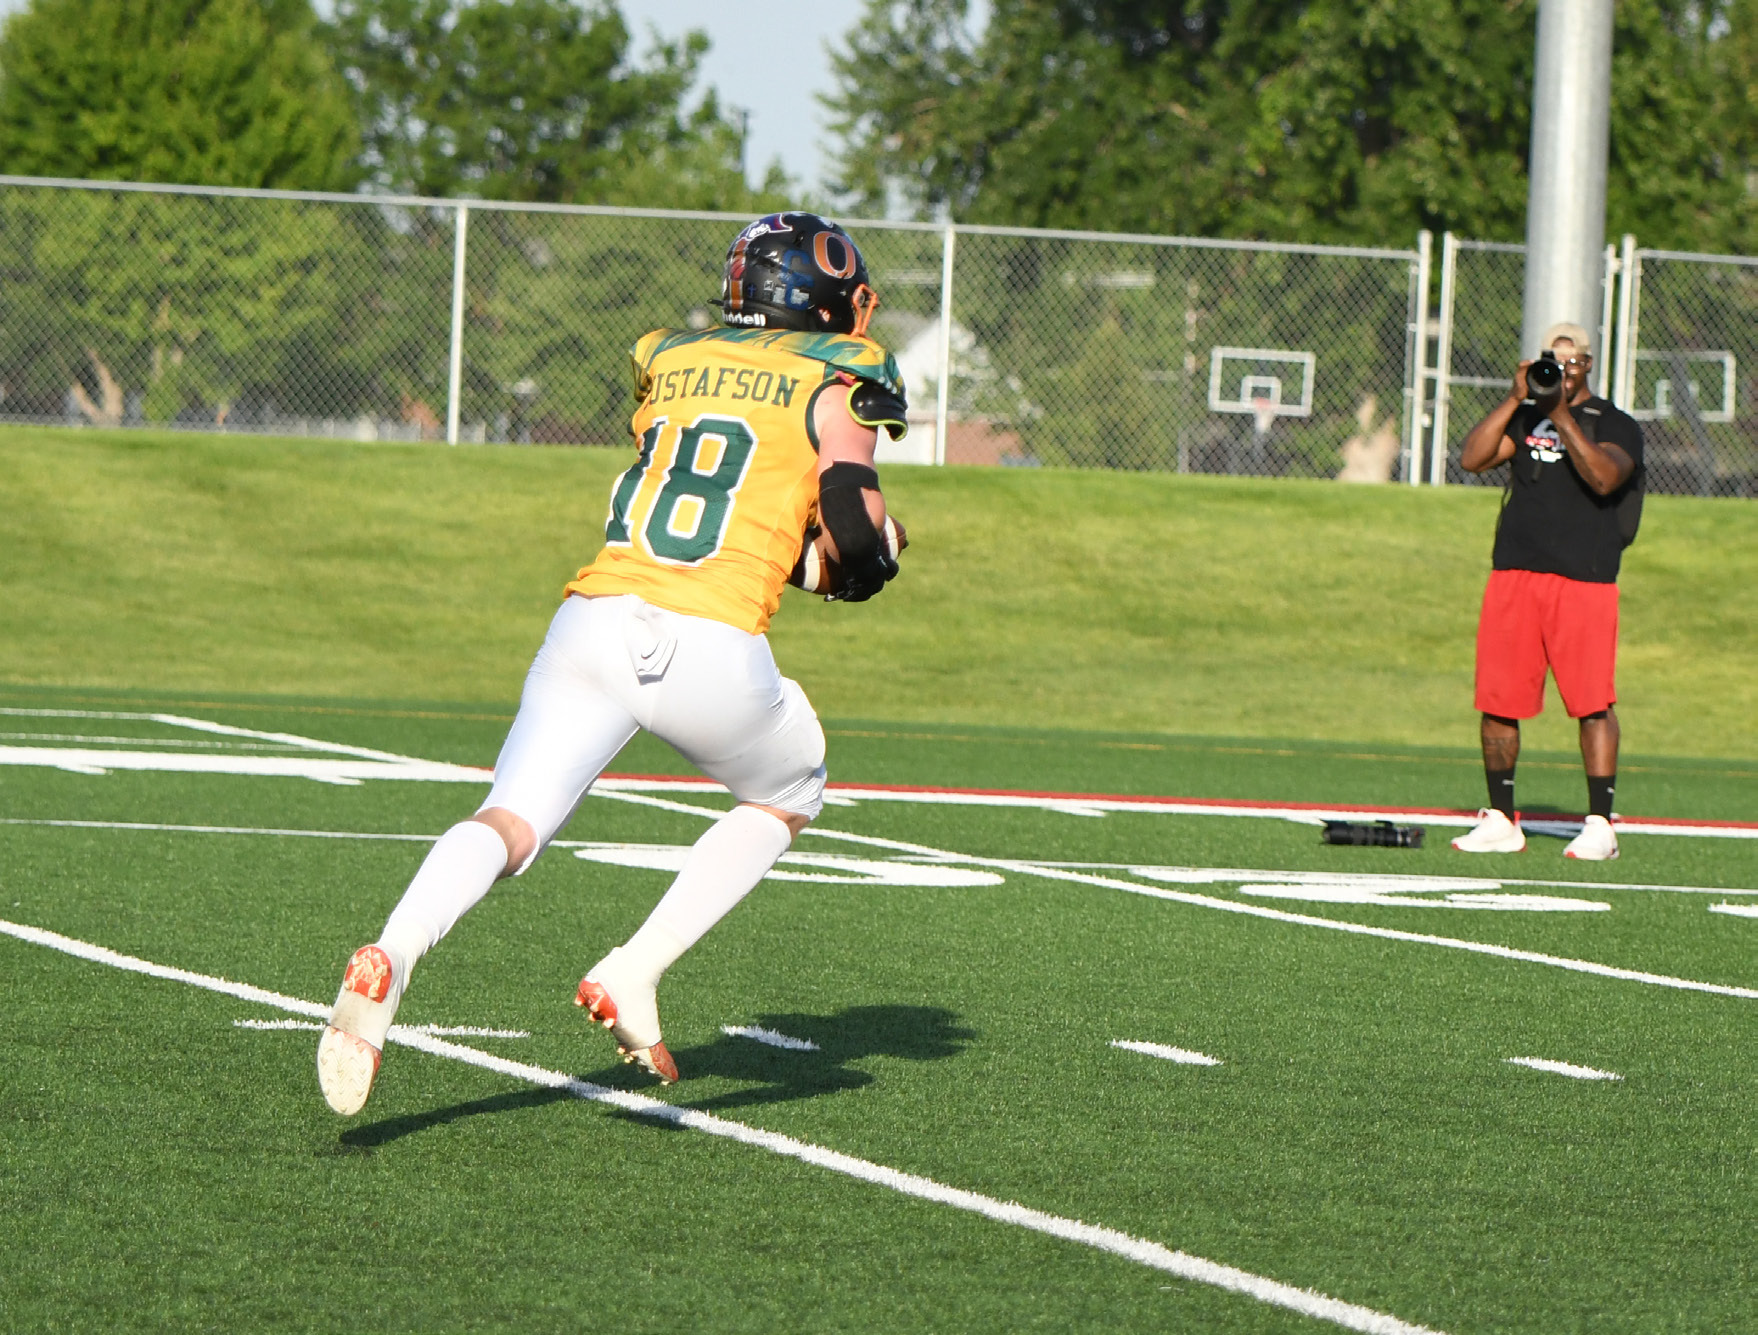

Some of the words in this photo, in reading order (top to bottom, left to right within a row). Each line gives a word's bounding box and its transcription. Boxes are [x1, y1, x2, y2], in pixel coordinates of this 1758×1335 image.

[814, 231, 856, 279] O
[648, 366, 801, 408] USTAFSON
[606, 413, 759, 567] 18
